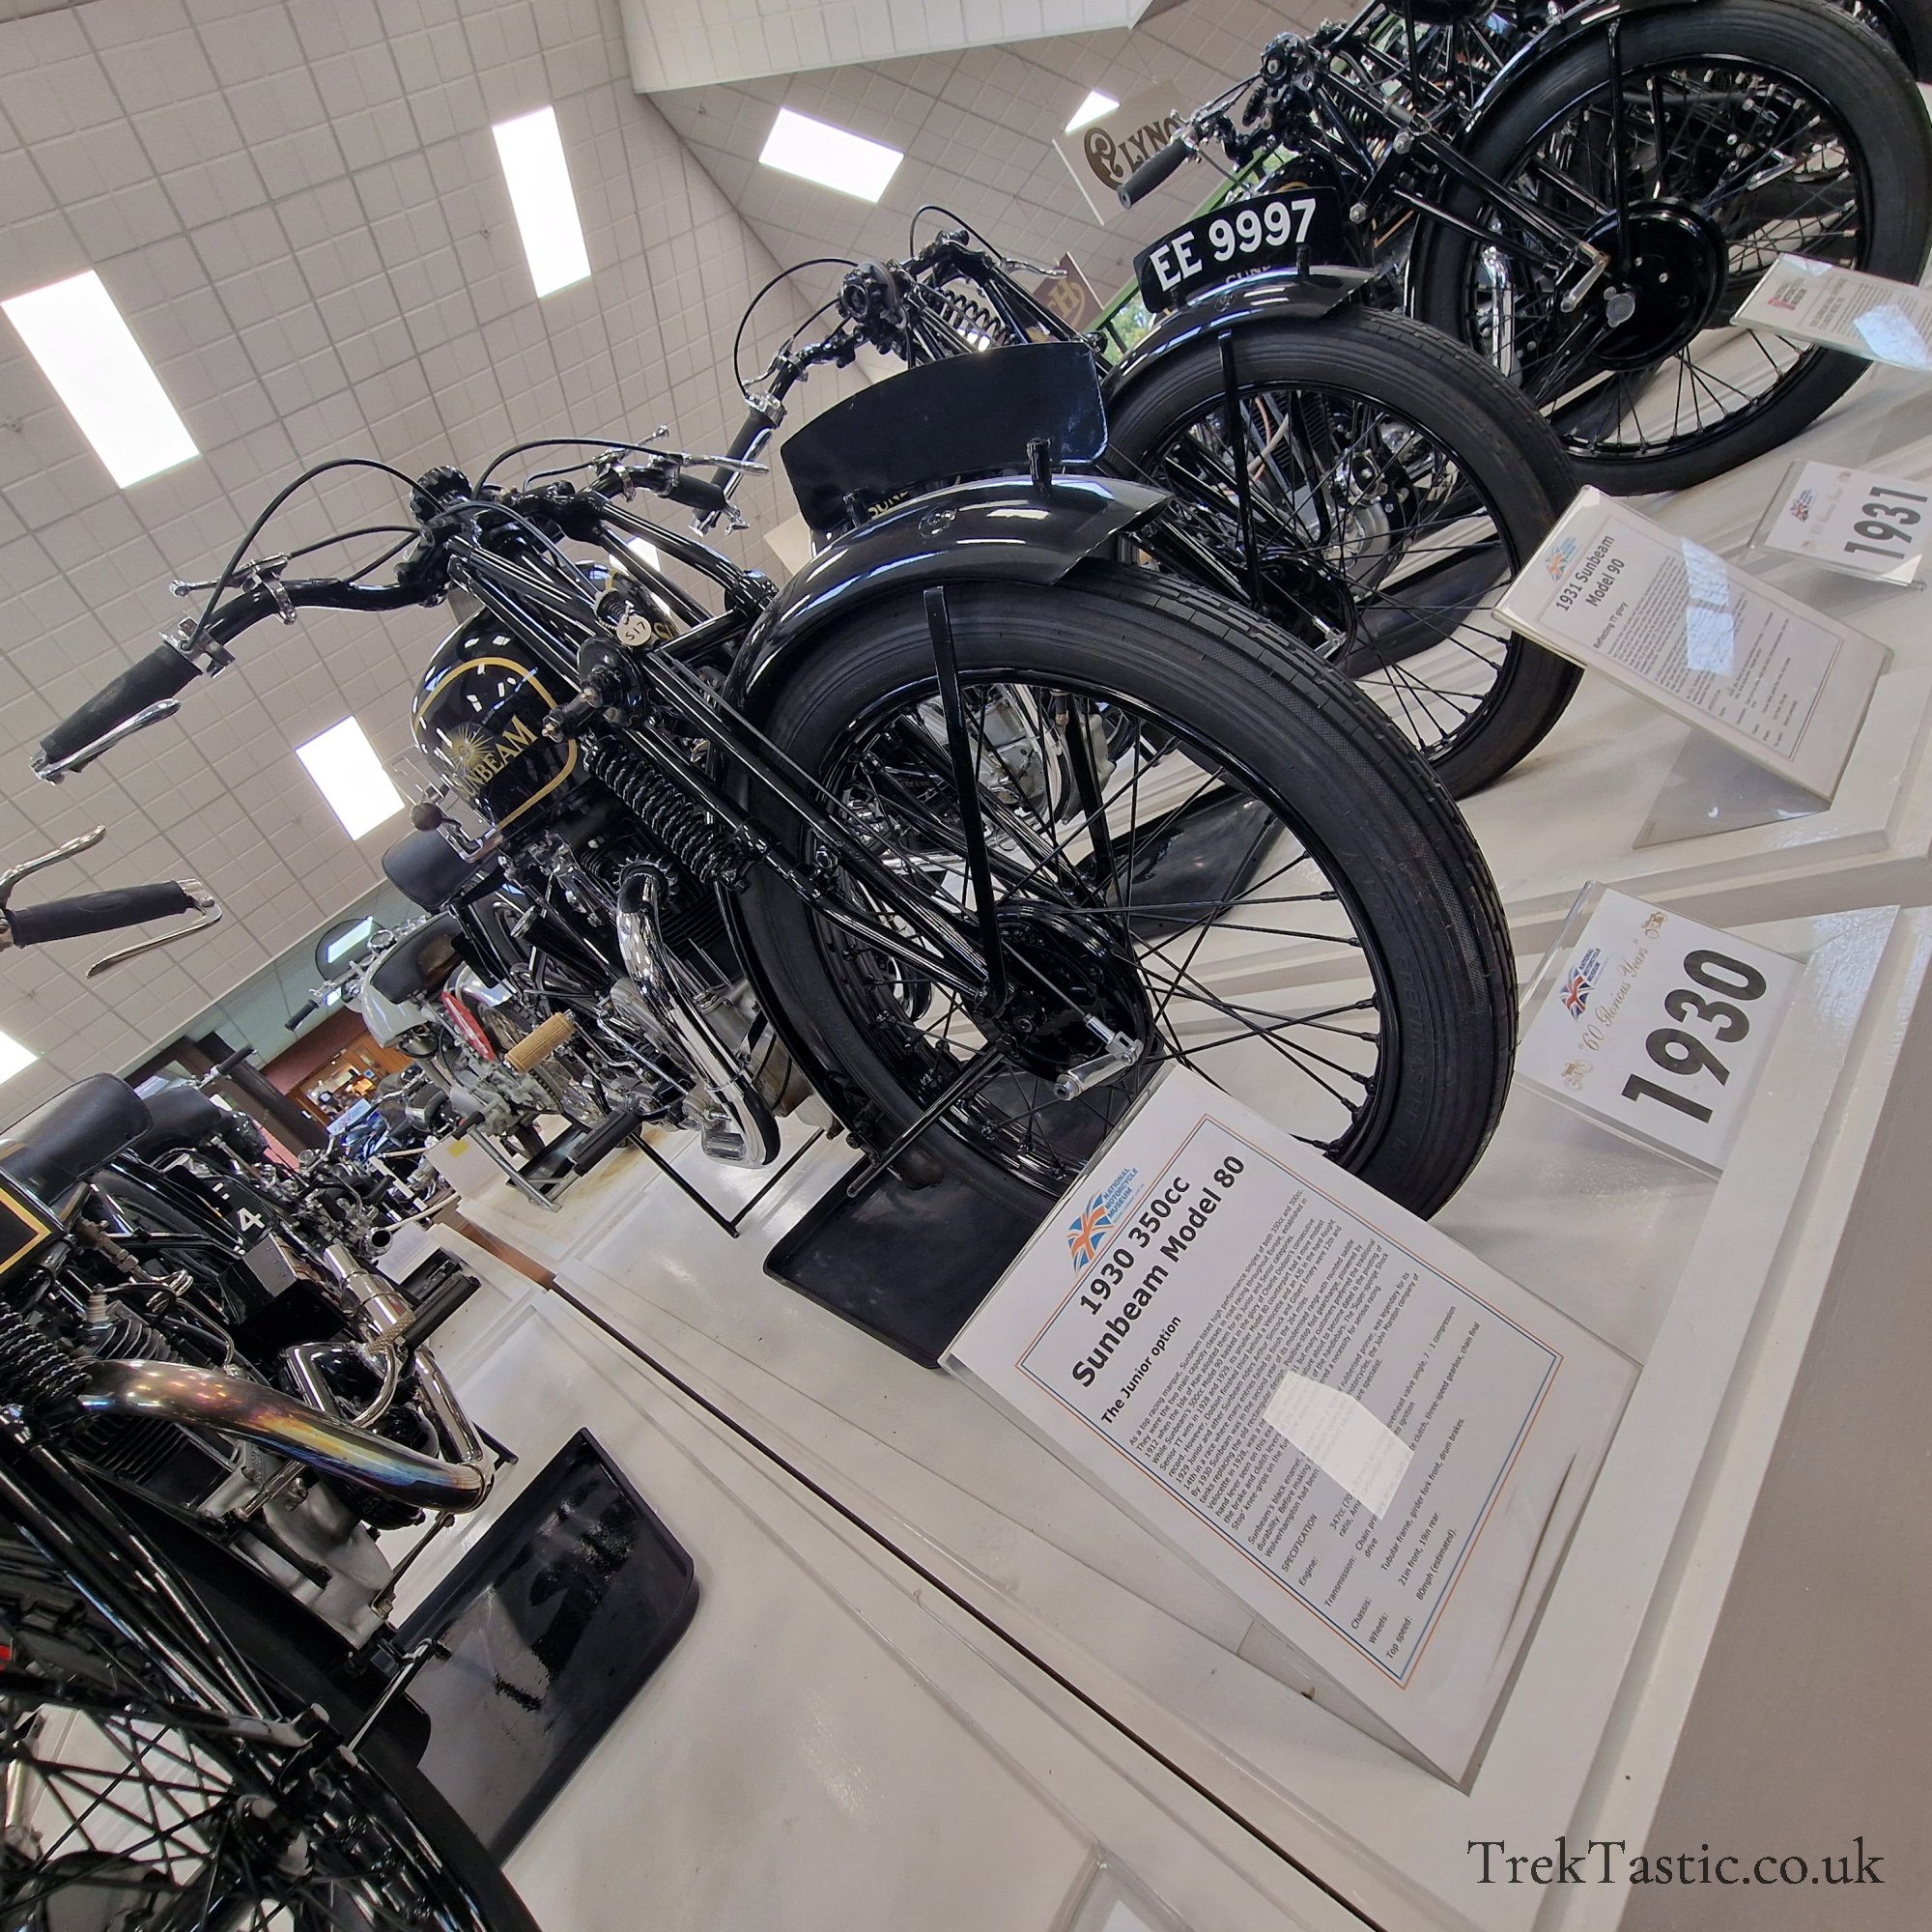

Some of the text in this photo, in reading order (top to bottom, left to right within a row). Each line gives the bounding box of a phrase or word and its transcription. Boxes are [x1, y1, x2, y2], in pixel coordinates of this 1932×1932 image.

[1150, 198, 1317, 292] EE 9997
[1843, 485, 1928, 559] 1931
[1552, 580, 1584, 612] 1931
[1572, 533, 1617, 584] Sunbeam
[1582, 556, 1627, 609] Model 90
[1620, 949, 1767, 1123] 1930
[1100, 1167, 1130, 1200] NATIONAL
[1103, 1166, 1139, 1210] MOTORCYCLE
[1106, 1186, 1133, 1219] MUSEUM
[1071, 1264, 1169, 1388] Sunbeam
[1158, 1185, 1222, 1263] Model
[1212, 1154, 1244, 1188] 80
[1079, 1247, 1134, 1316] 1930
[1126, 1176, 1190, 1249] 350cc
[1186, 1347, 1208, 1376] capacity
[1204, 1324, 1223, 1350] classes
[1233, 1285, 1250, 1306] racing
[1244, 1254, 1271, 1289] throughout
[1279, 1202, 1304, 1235] established
[1198, 1345, 1221, 1375] adopted
[1237, 1292, 1256, 1314] Junior
[1258, 1262, 1275, 1284] Senior
[1202, 1393, 1224, 1422] Dodson
[1217, 1368, 1240, 1397] finished
[1244, 1330, 1264, 1354] behind
[1262, 1298, 1285, 1328] Velocette
[1310, 1217, 1337, 1252] hard-fought
[1218, 1334, 1238, 1360] basked
[1260, 1273, 1279, 1296] Charlie
[1291, 1216, 1316, 1251] consecutive
[1312, 1236, 1377, 1336] customers preferred traditional
[1325, 1250, 1379, 1333] become pivoting
[1381, 1305, 1401, 1332] Marston
[1395, 1279, 1416, 1308] company
[1146, 1395, 1165, 1418] racing
[1179, 1338, 1204, 1371] Sunbeam
[1198, 1320, 1214, 1341] listed
[1219, 1271, 1248, 1310] performance
[1242, 1251, 1262, 1274] singles
[1157, 1217, 1325, 1472] Senior smaller counterpart modest
[1208, 1236, 1355, 1468] Sunbeam second modernised rounded saddle
[1329, 1333, 1352, 1364] necessity
[1352, 1301, 1370, 1325] serious
[1339, 1350, 1363, 1388] rubberised
[1378, 1287, 1401, 1320] legendary
[1459, 1334, 1474, 1354] chain
[1466, 1320, 1481, 1337] final
[1099, 1316, 1181, 1424] The Junior option
[1185, 1281, 1306, 1466] Junior Sunbeam riders Arthur Simcock Gilbert
[1209, 1449, 1236, 1484] replacing
[1244, 1387, 1273, 1428] rectangular
[1281, 1325, 1312, 1368] Positive-stop
[1336, 1250, 1358, 1281] pioneered
[1236, 1334, 1284, 1403] entries failed finish
[1383, 1395, 1406, 1430] overhead
[1401, 1378, 1416, 1399] valve
[1431, 1304, 1457, 1344] compression
[1423, 1378, 1450, 1421] three-speed
[1397, 1399, 1416, 1428] ignition
[1252, 1430, 1283, 1475] clutch levers
[1205, 1474, 1232, 1511] Velocette
[1240, 1470, 1270, 1512] knee-grips
[1275, 1488, 1296, 1515] Before
[1291, 1461, 1312, 1492] making
[1327, 1505, 1347, 1531] 347cc
[1379, 1540, 1401, 1573] Tubular
[1407, 1493, 1425, 1519] girder
[1418, 1478, 1434, 1496] fork
[1437, 1439, 1453, 1461] drum
[1263, 1499, 1302, 1559] Wolverhampton
[1279, 1512, 1318, 1573] SPECIFICATION
[1353, 1526, 1372, 1551] Chain
[1362, 1536, 1379, 1559] drive
[1397, 1565, 1412, 1587] 21in
[1417, 1526, 1433, 1547] 19in
[1414, 1571, 1435, 1602] 80mph
